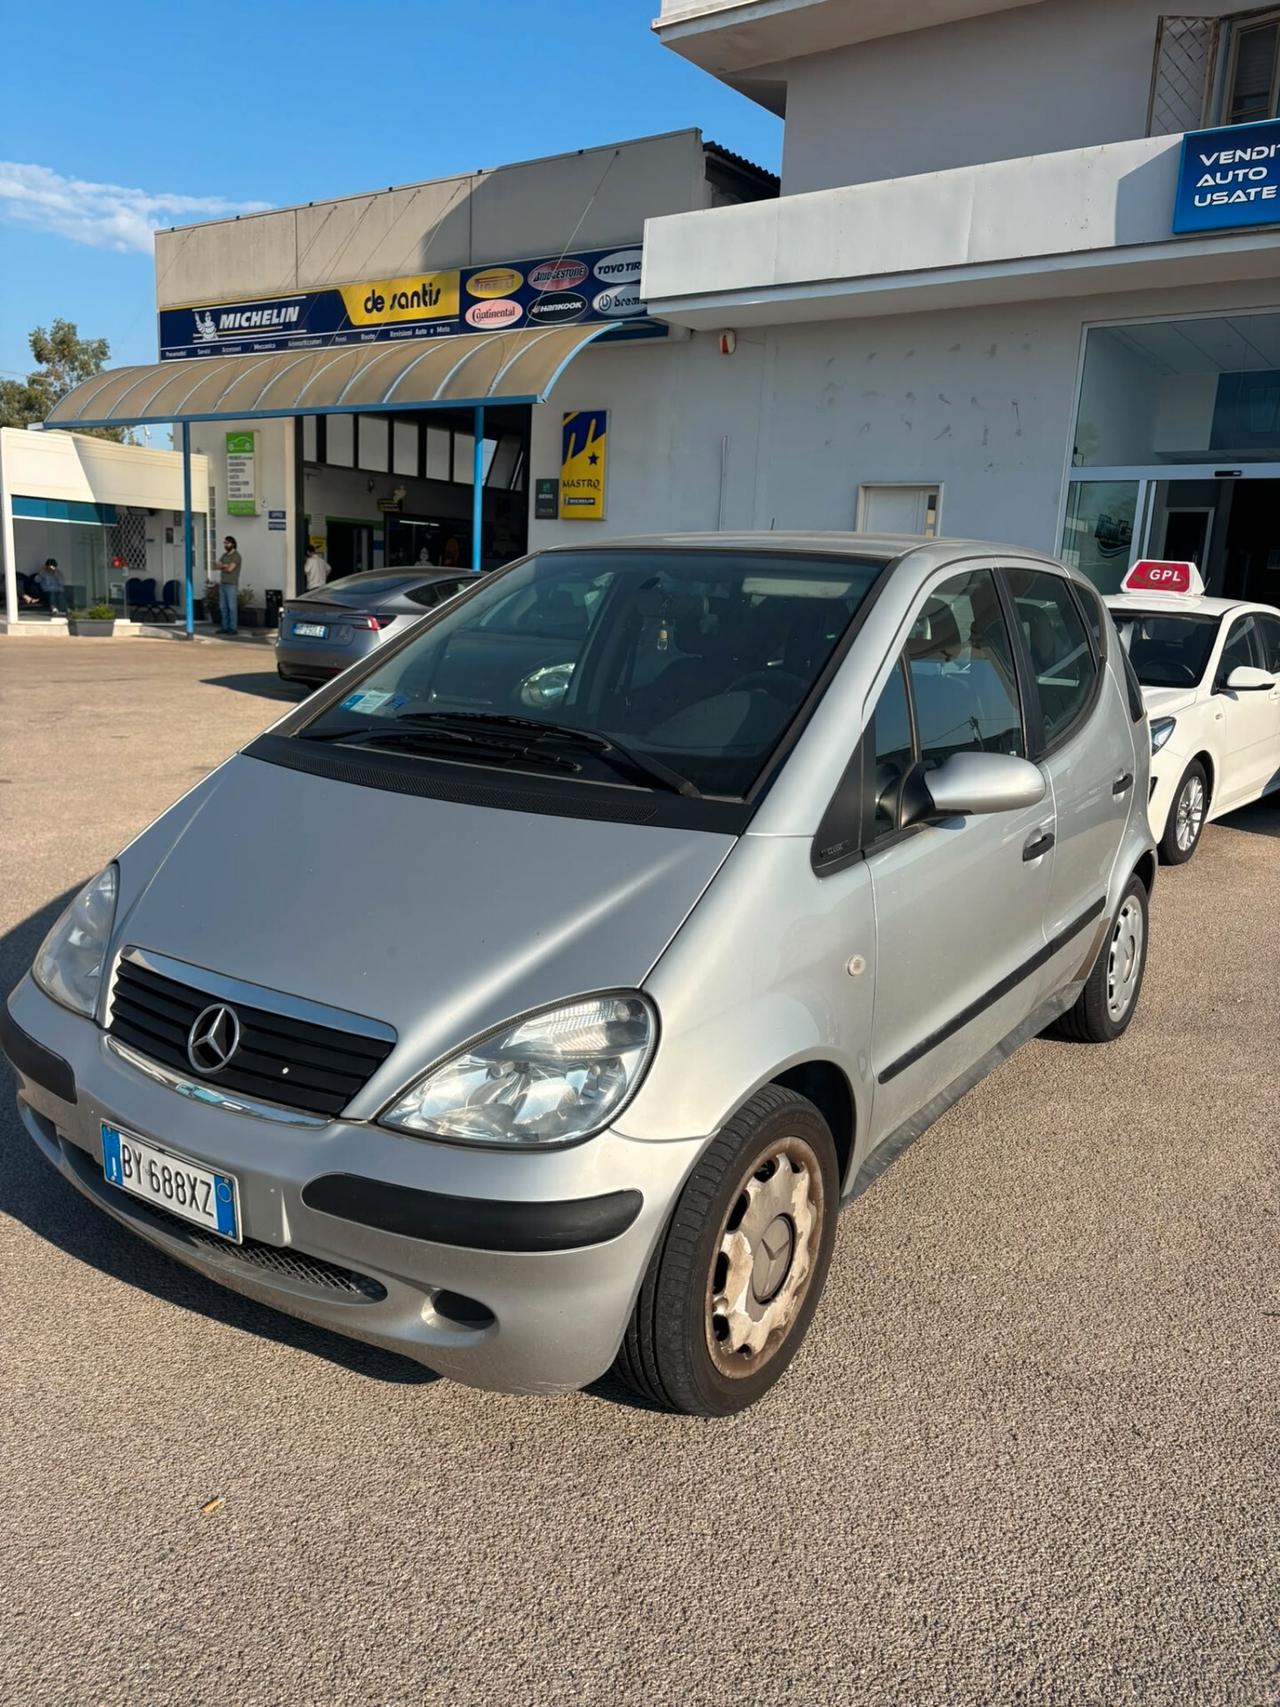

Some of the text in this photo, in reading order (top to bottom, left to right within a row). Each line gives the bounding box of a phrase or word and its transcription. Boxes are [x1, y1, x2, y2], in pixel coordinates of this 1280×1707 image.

[1199, 143, 1280, 167] VENDI
[1196, 167, 1268, 188] AUTO
[1194, 185, 1279, 207] USATE
[533, 266, 585, 283] BRIDGESTONE
[598, 263, 624, 275] TOYO
[363, 282, 441, 314] de santis
[614, 295, 643, 307] brem
[219, 305, 300, 330] MICHELIN
[472, 307, 516, 325] Continental
[415, 327, 427, 335] Auto
[562, 479, 601, 491] MASTRO
[1150, 569, 1181, 582] GPL
[122, 1143, 214, 1218] BY 688XZ
